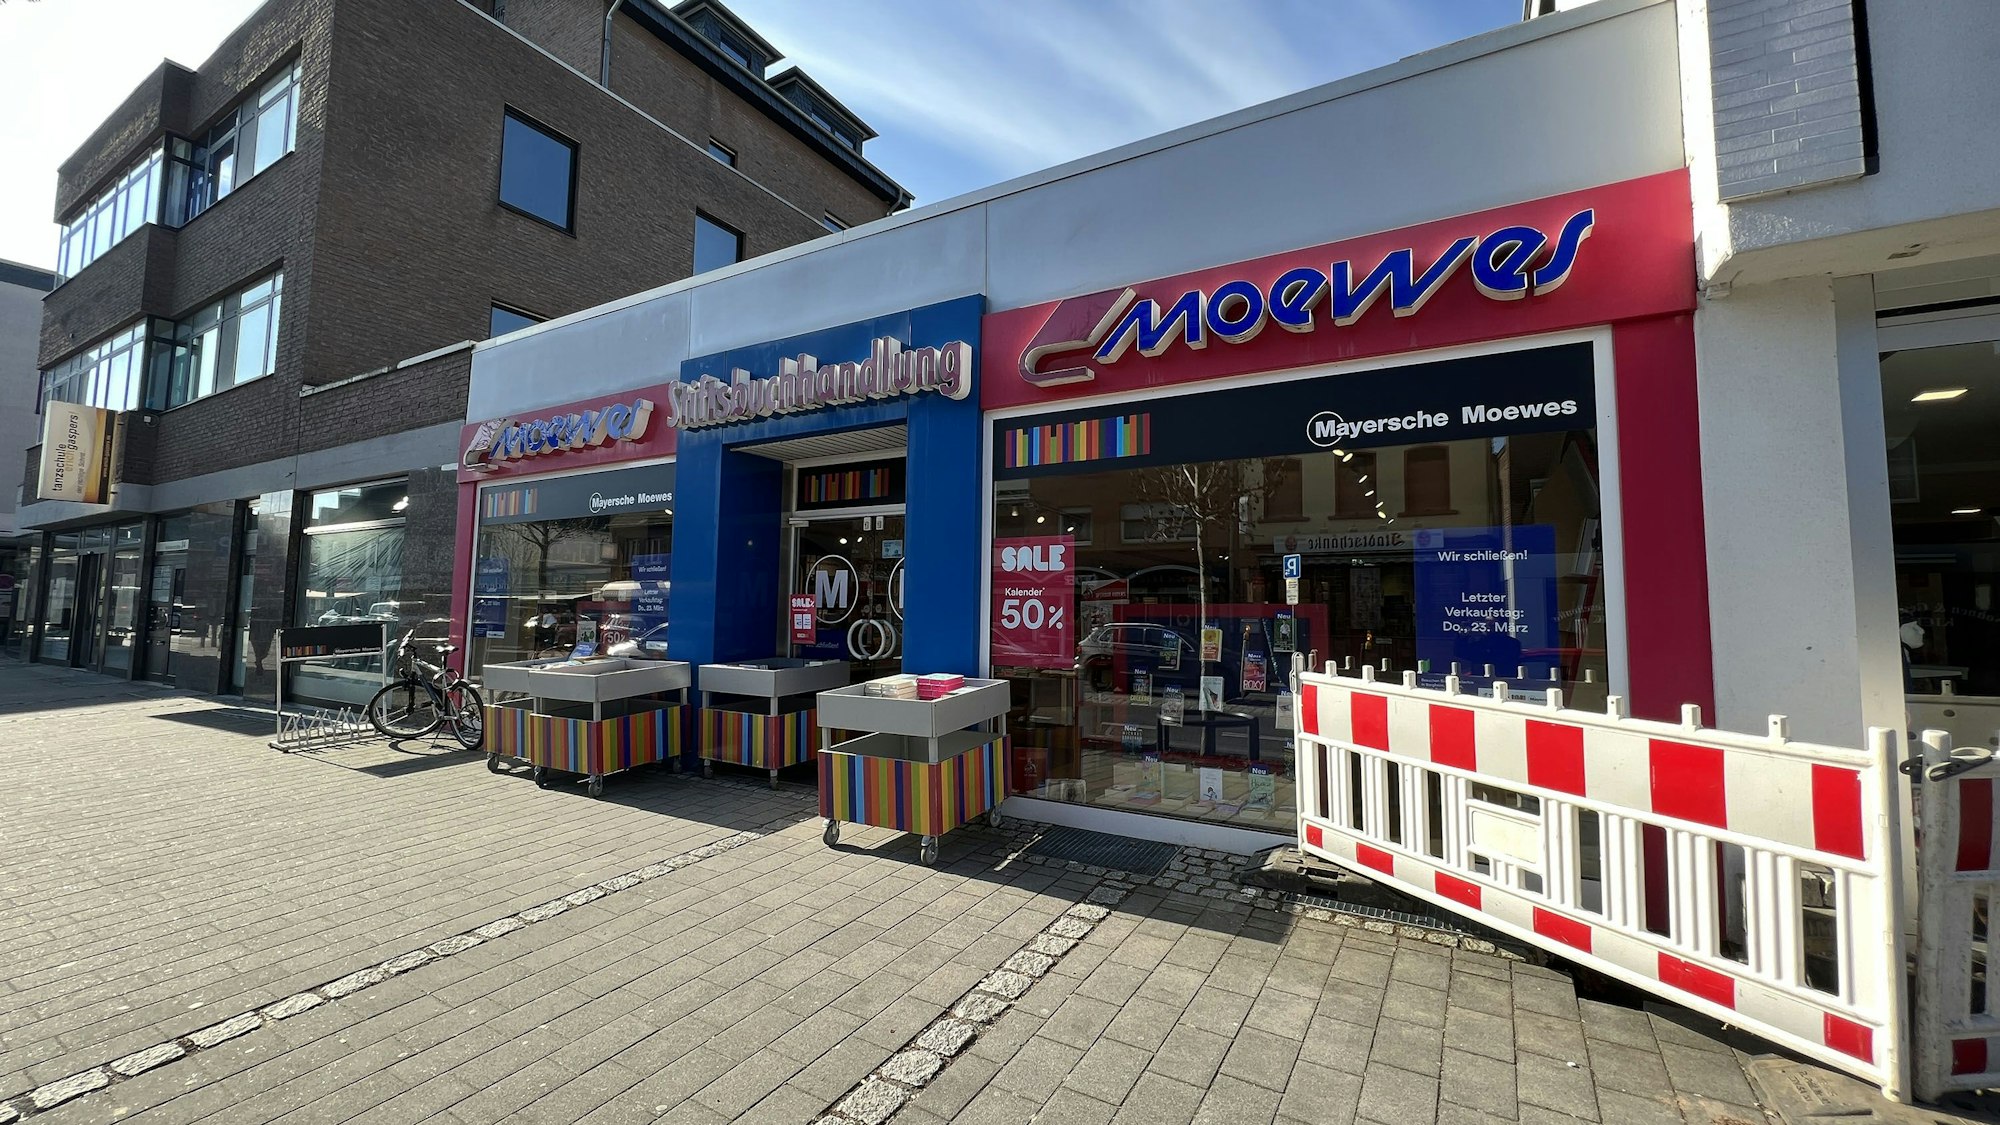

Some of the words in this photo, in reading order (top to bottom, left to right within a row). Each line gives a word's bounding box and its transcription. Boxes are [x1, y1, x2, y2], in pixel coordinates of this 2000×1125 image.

[667, 335, 973, 430] Stiftsbuchhandlung
[1314, 410, 1449, 439] Mayersche
[1461, 399, 1578, 425] Moewes
[52, 444, 67, 492] tanzschule
[591, 494, 635, 508] Mayersche
[637, 492, 673, 504] Moewes
[1001, 544, 1066, 572] SALE
[1437, 551, 1460, 562] Wir
[1463, 549, 1528, 562] schließen!
[814, 569, 849, 609] M
[1461, 592, 1507, 603] Letzter
[1444, 606, 1525, 620] Verkaufstag:
[1442, 621, 1468, 634] Do.,
[1471, 621, 1491, 632] 23.
[1494, 621, 1529, 633] März
[1242, 679, 1266, 690] ROXY
[1145, 755, 1158, 763] Neu
[1252, 767, 1267, 775] Neu
